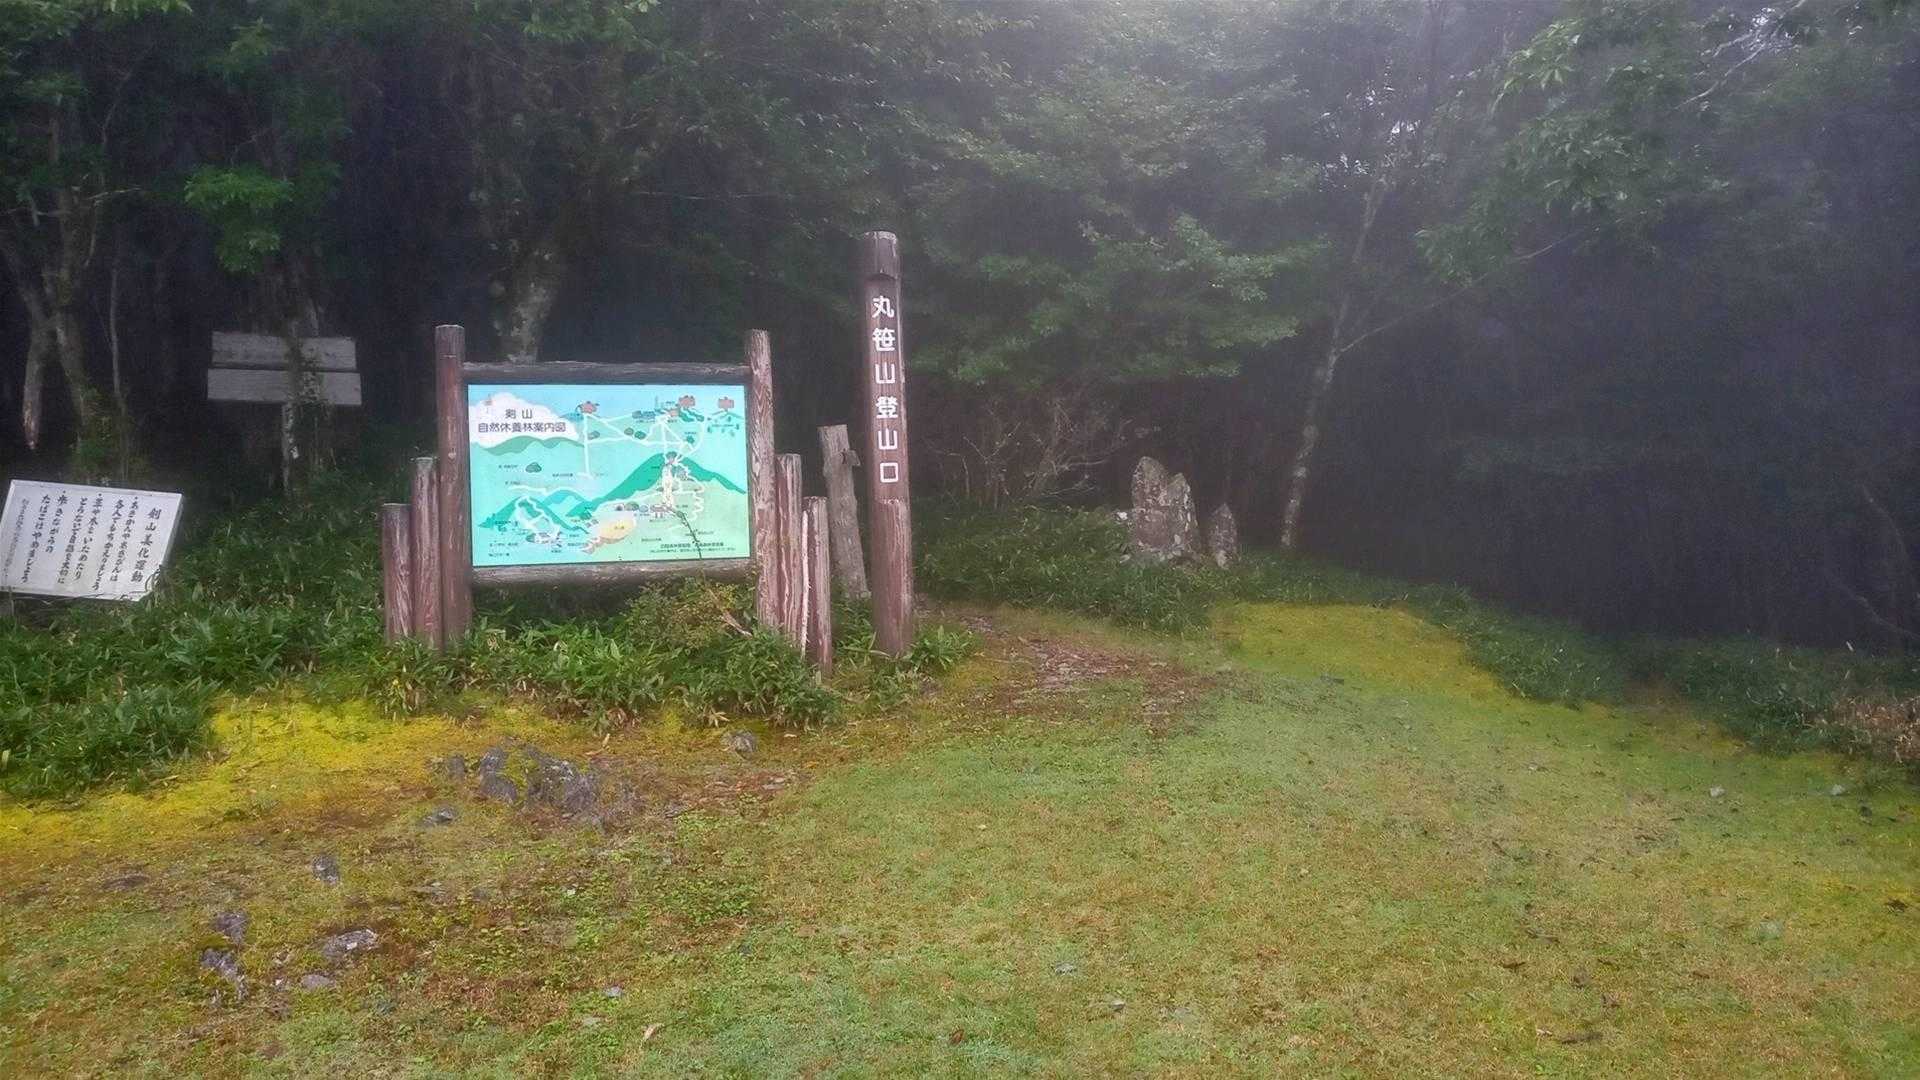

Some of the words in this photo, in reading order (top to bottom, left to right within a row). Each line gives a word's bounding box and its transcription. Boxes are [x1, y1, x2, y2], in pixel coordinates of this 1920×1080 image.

[478, 422, 566, 433] 自然休養林案内図
[871, 295, 899, 483] 丸笹山登山口
